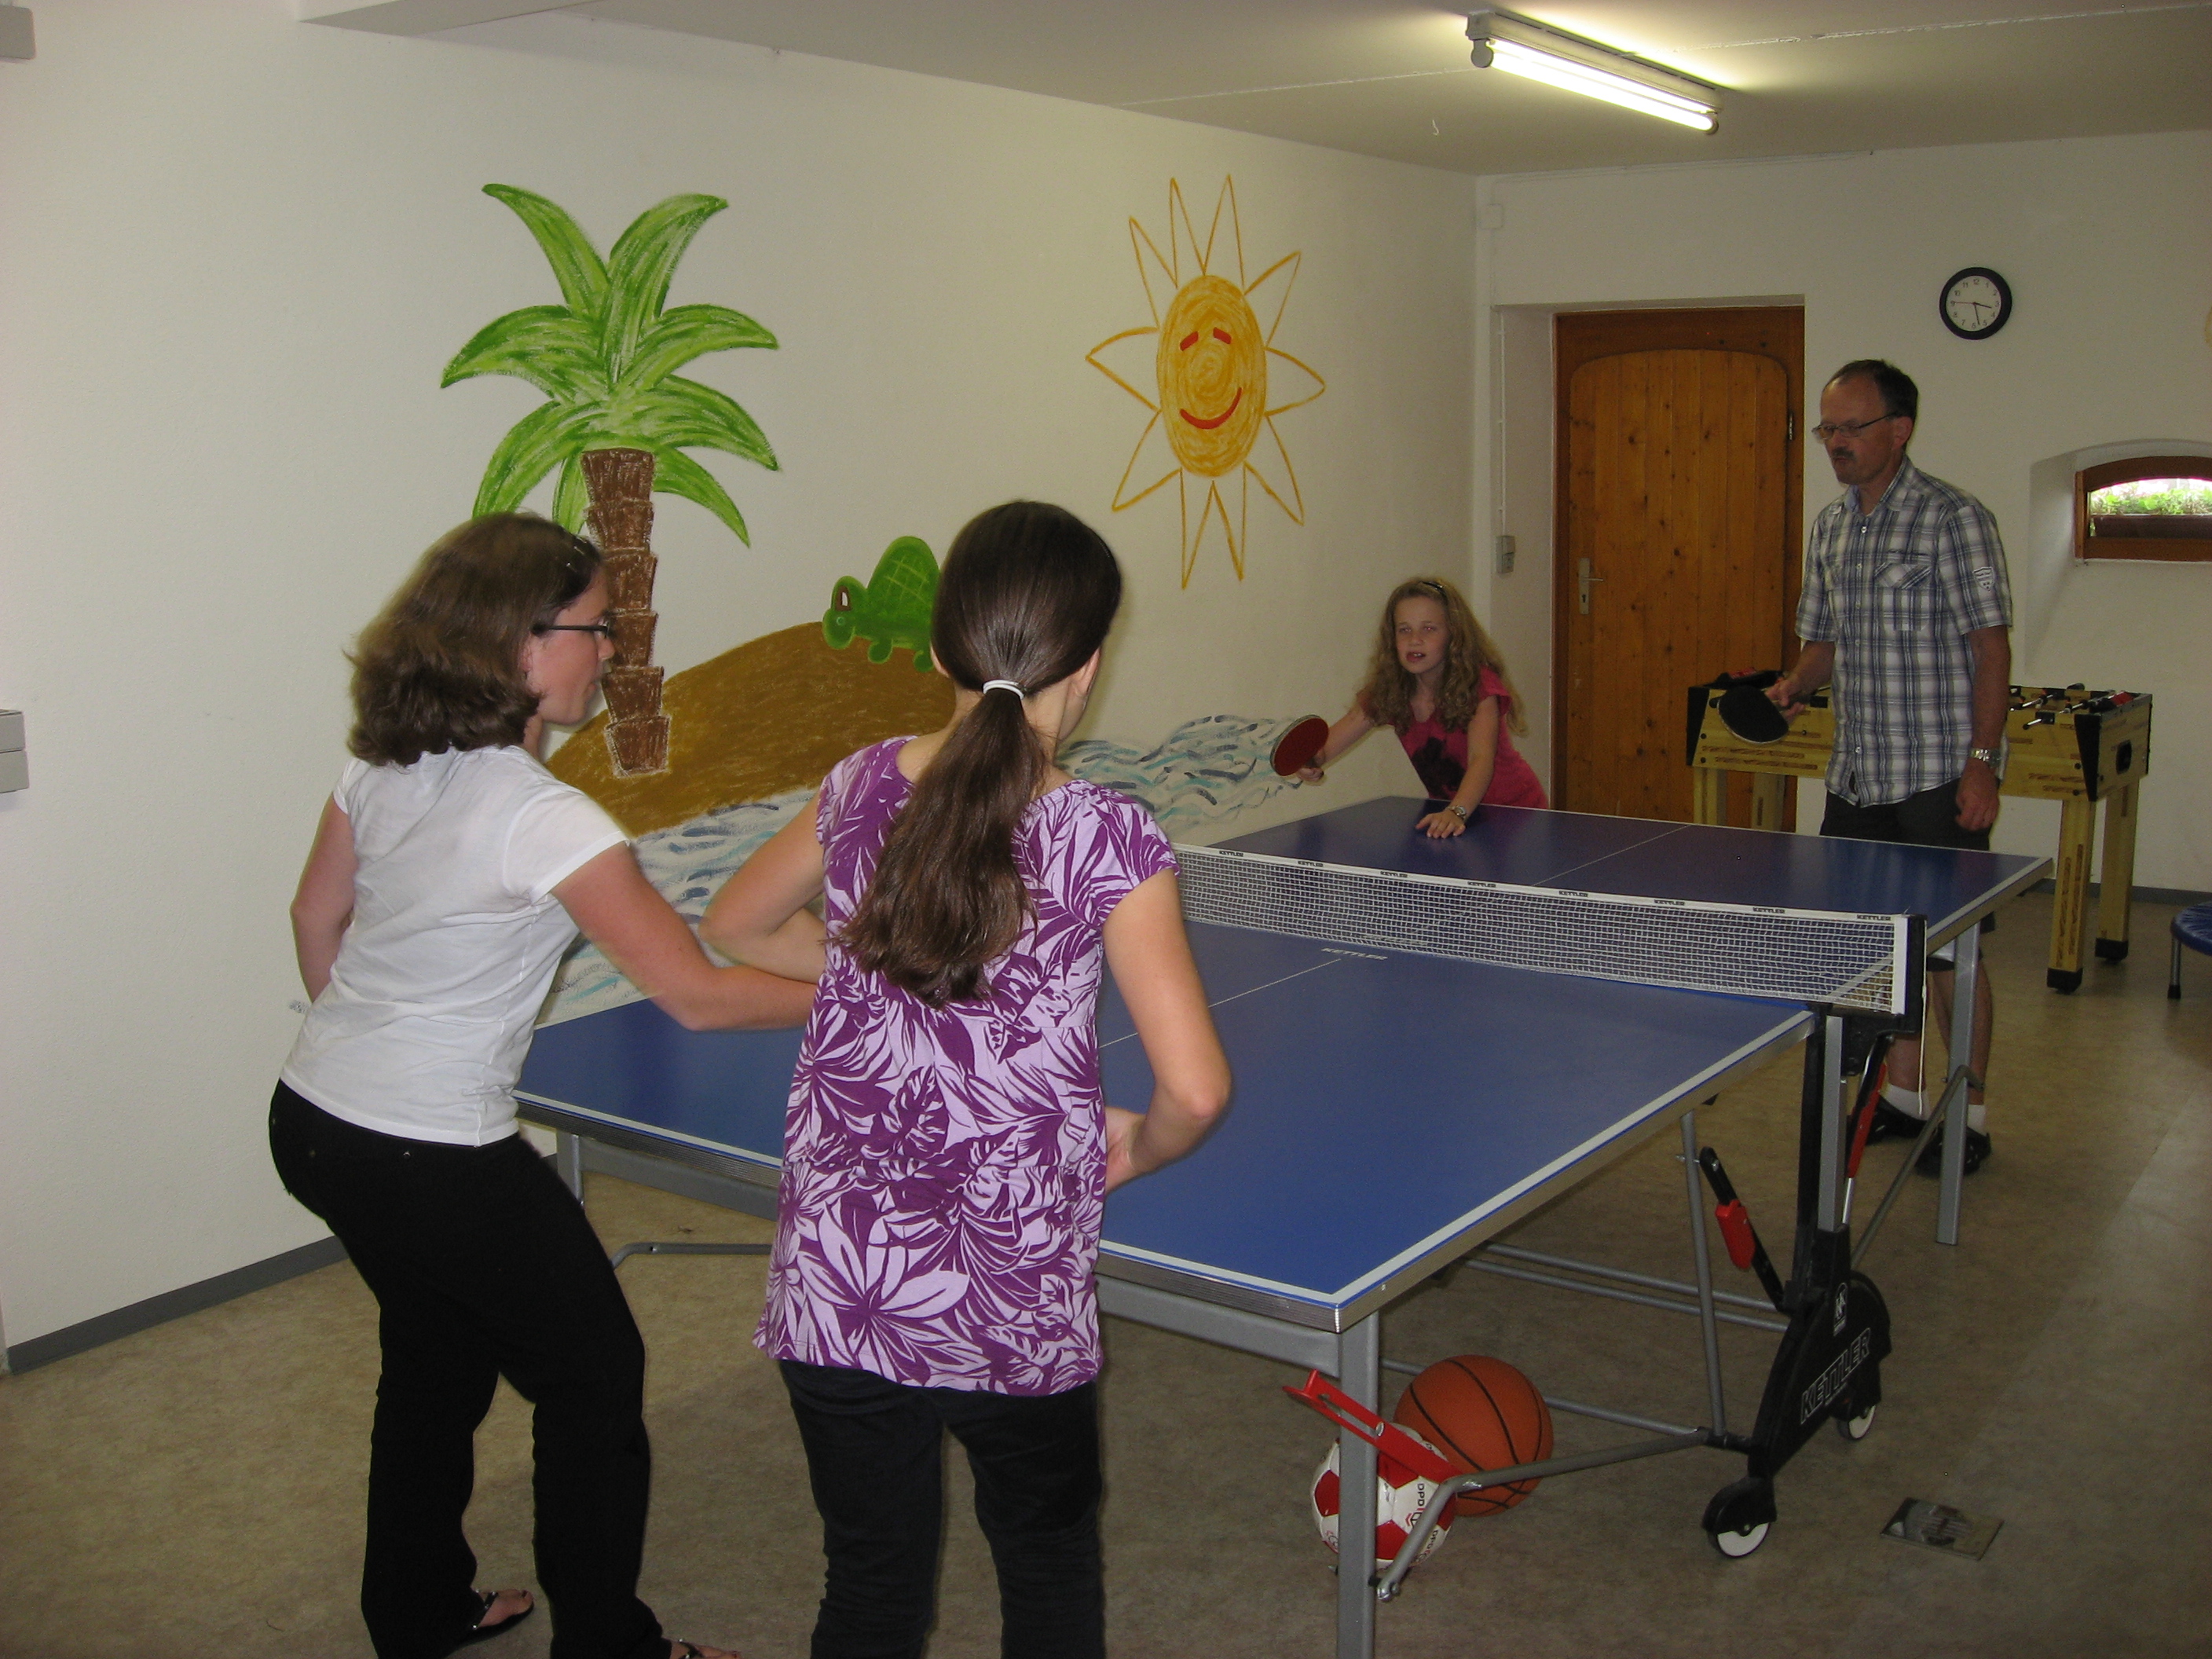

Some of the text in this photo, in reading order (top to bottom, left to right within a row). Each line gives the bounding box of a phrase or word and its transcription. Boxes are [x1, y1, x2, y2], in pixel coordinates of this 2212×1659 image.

[1320, 947, 1388, 960] KETTLER
[1800, 1327, 1871, 1425] KETTLER
[1417, 1483, 1426, 1507] DPD
